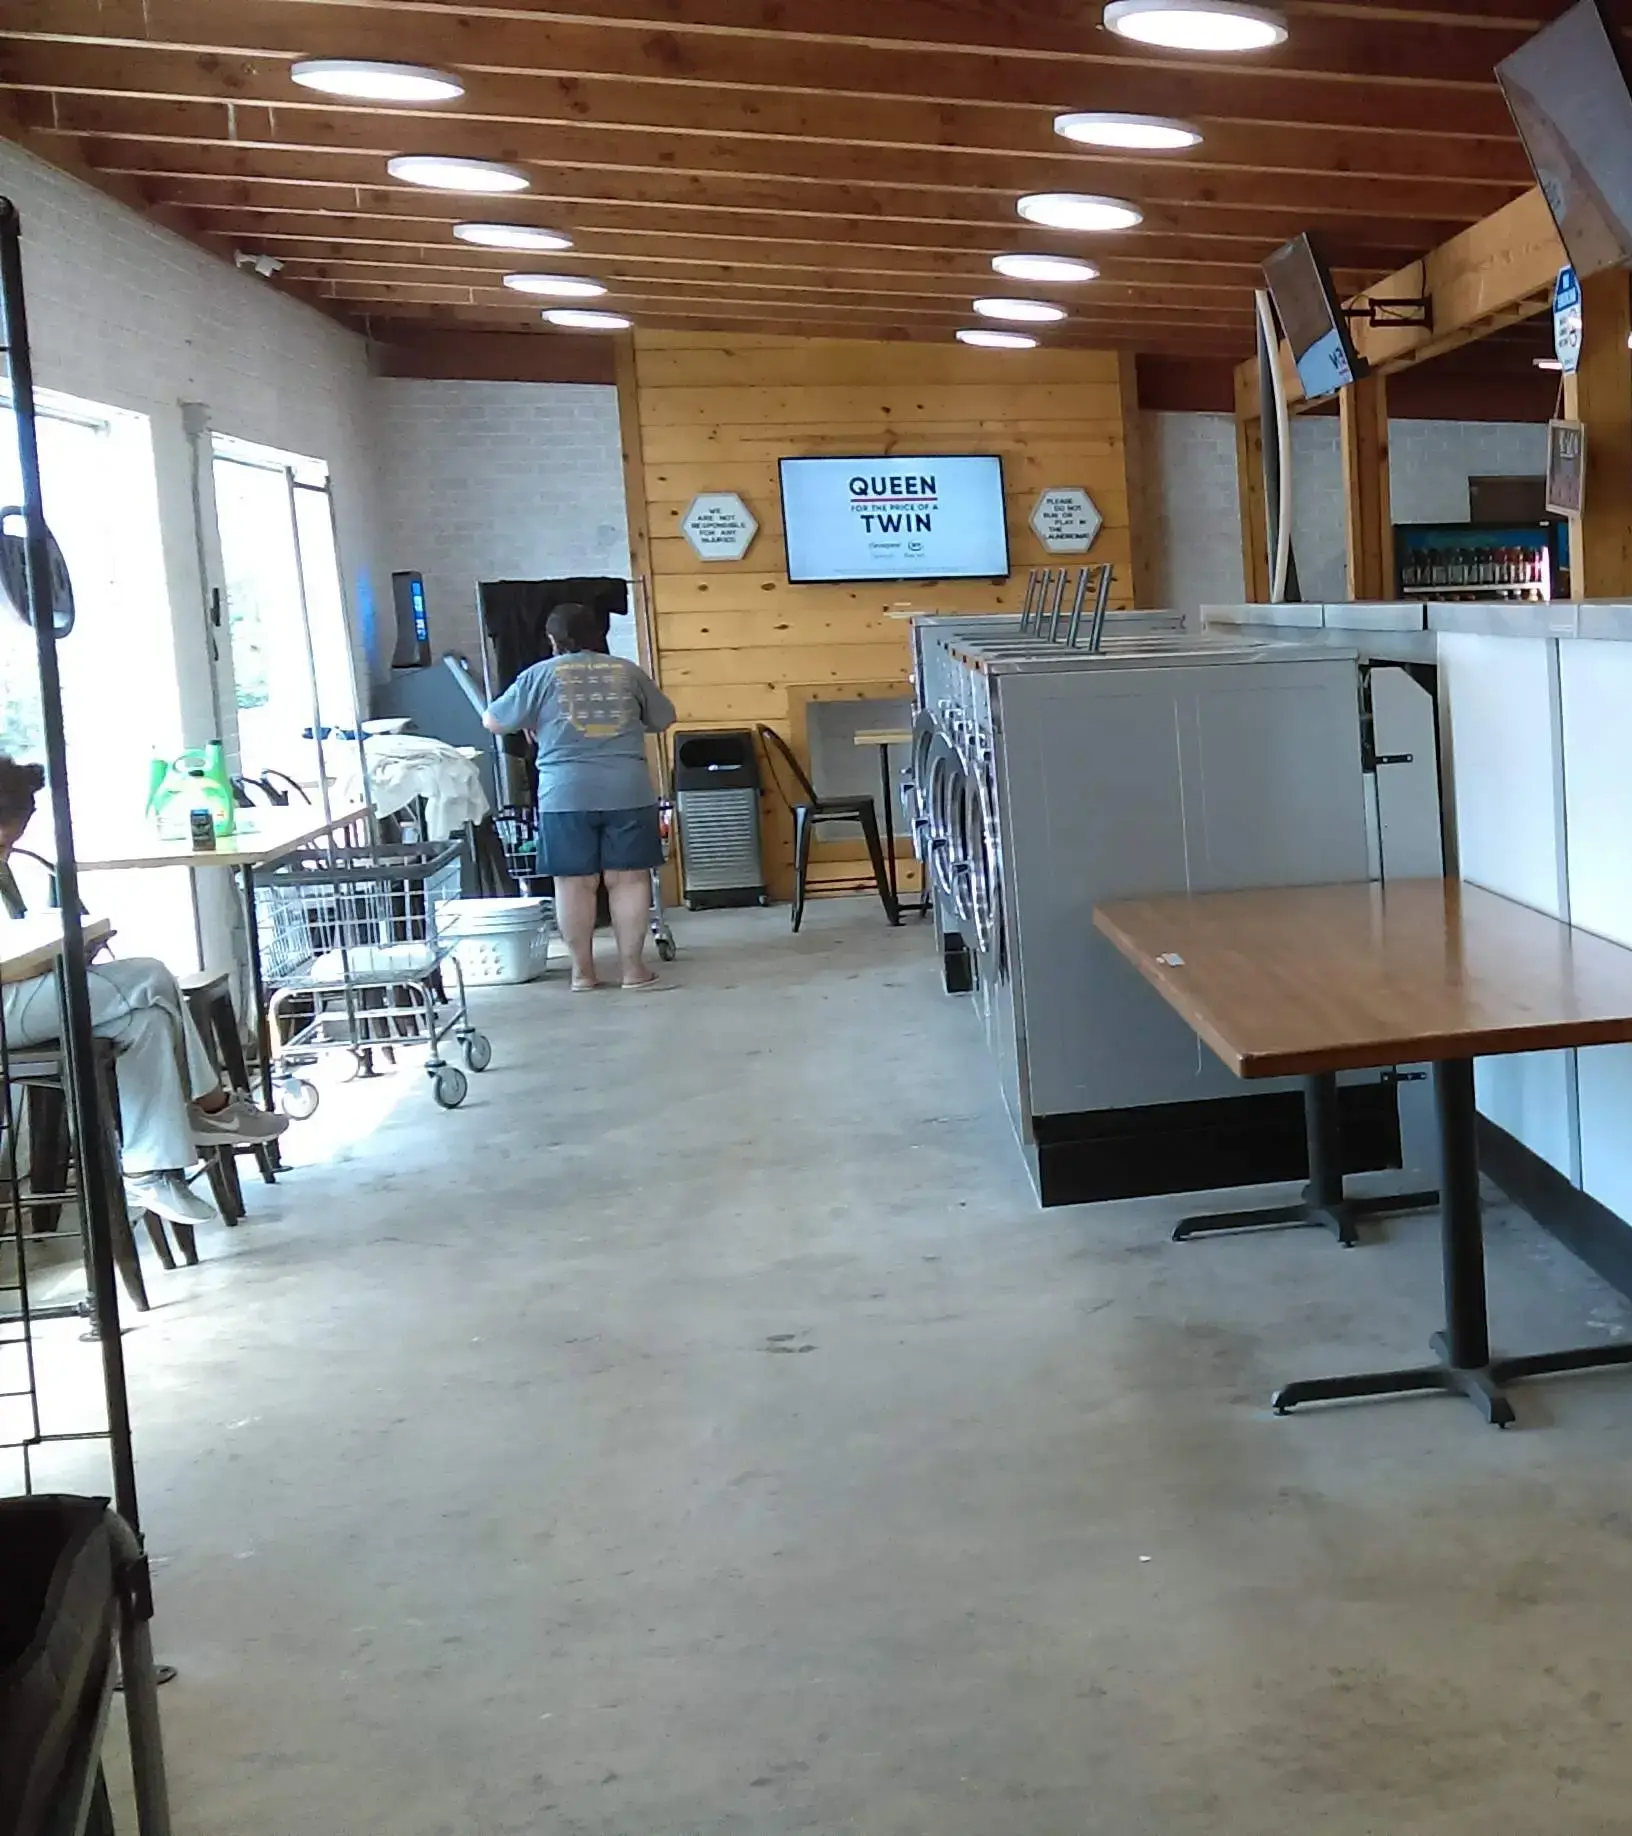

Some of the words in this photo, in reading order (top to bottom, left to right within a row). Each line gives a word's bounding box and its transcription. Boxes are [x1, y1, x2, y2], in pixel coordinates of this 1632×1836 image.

[849, 475, 937, 496] QUEEN
[851, 504, 868, 512] FOR
[871, 504, 887, 512] THE
[889, 503, 915, 511] PRICE
[917, 503, 929, 511] OF
[860, 513, 932, 533] TWIN
